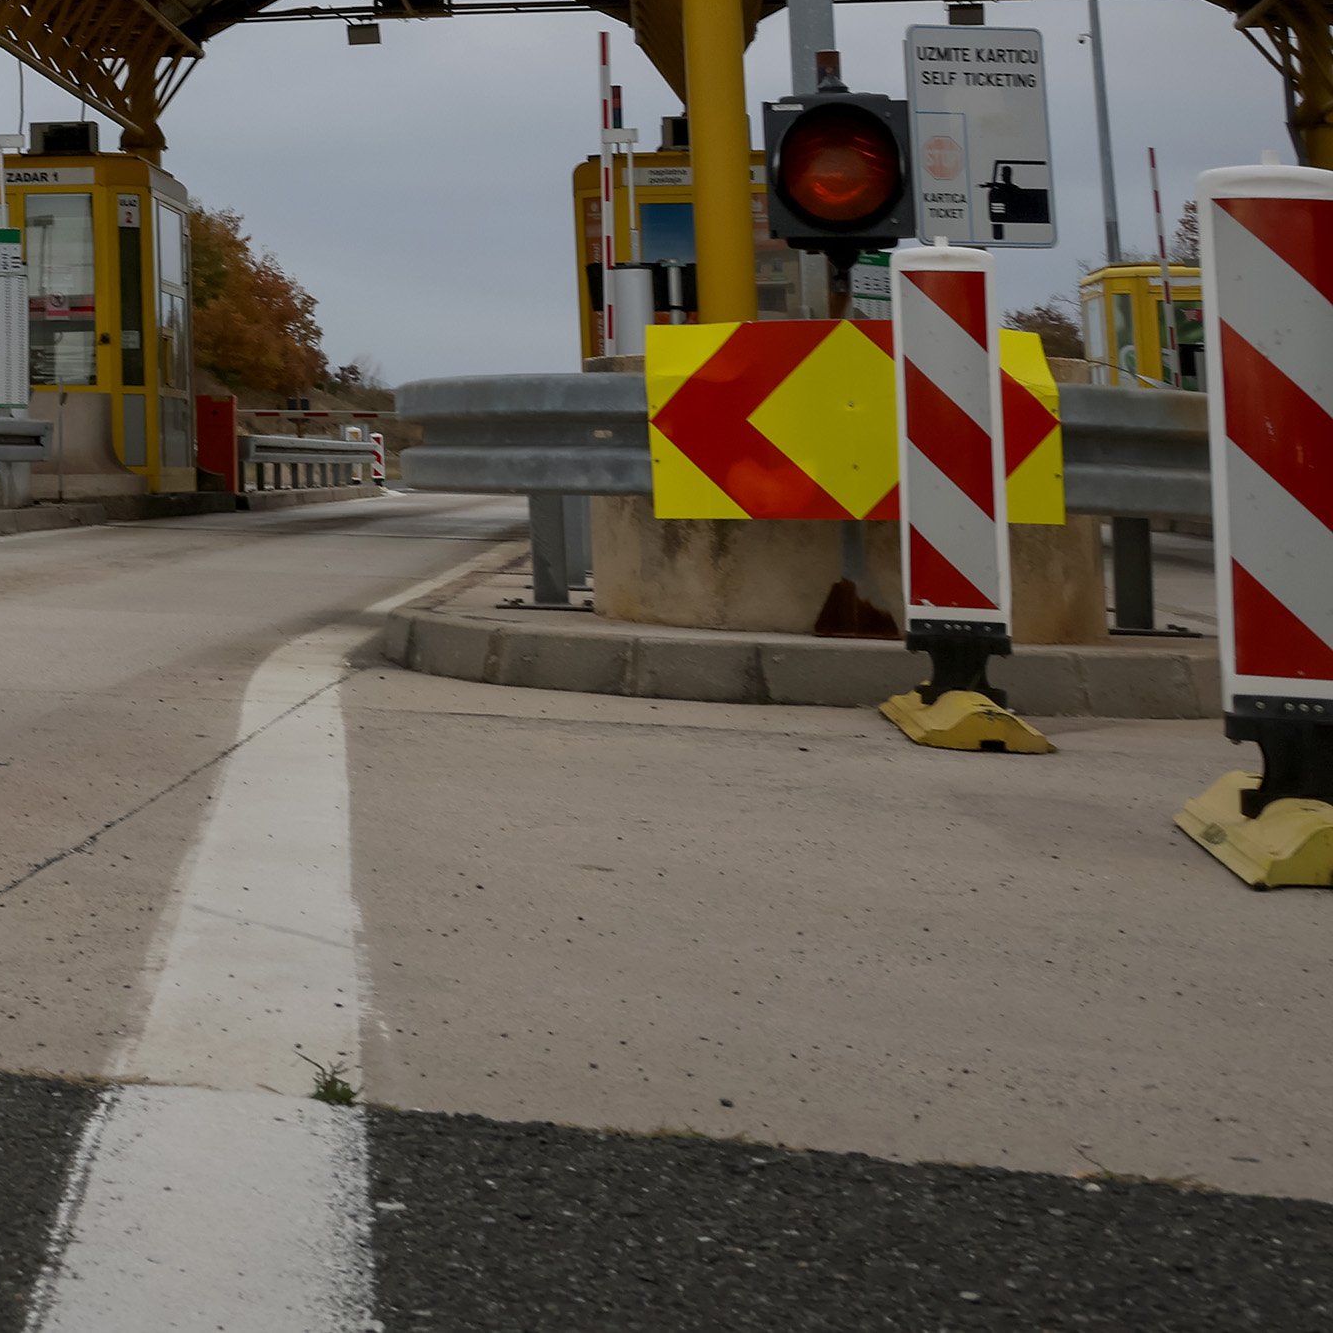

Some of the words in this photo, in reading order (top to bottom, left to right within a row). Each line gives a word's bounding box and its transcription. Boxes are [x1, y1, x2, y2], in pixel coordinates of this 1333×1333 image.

[916, 46, 972, 63] UZMITE
[975, 47, 1039, 65] KARTICU
[921, 71, 957, 86] SELF
[963, 72, 1037, 89] TICKETING
[6, 172, 49, 183] ZADAR
[52, 171, 59, 182] 1
[923, 192, 968, 204] KARTICA
[125, 211, 133, 224] 2
[927, 207, 965, 219] TICKET
